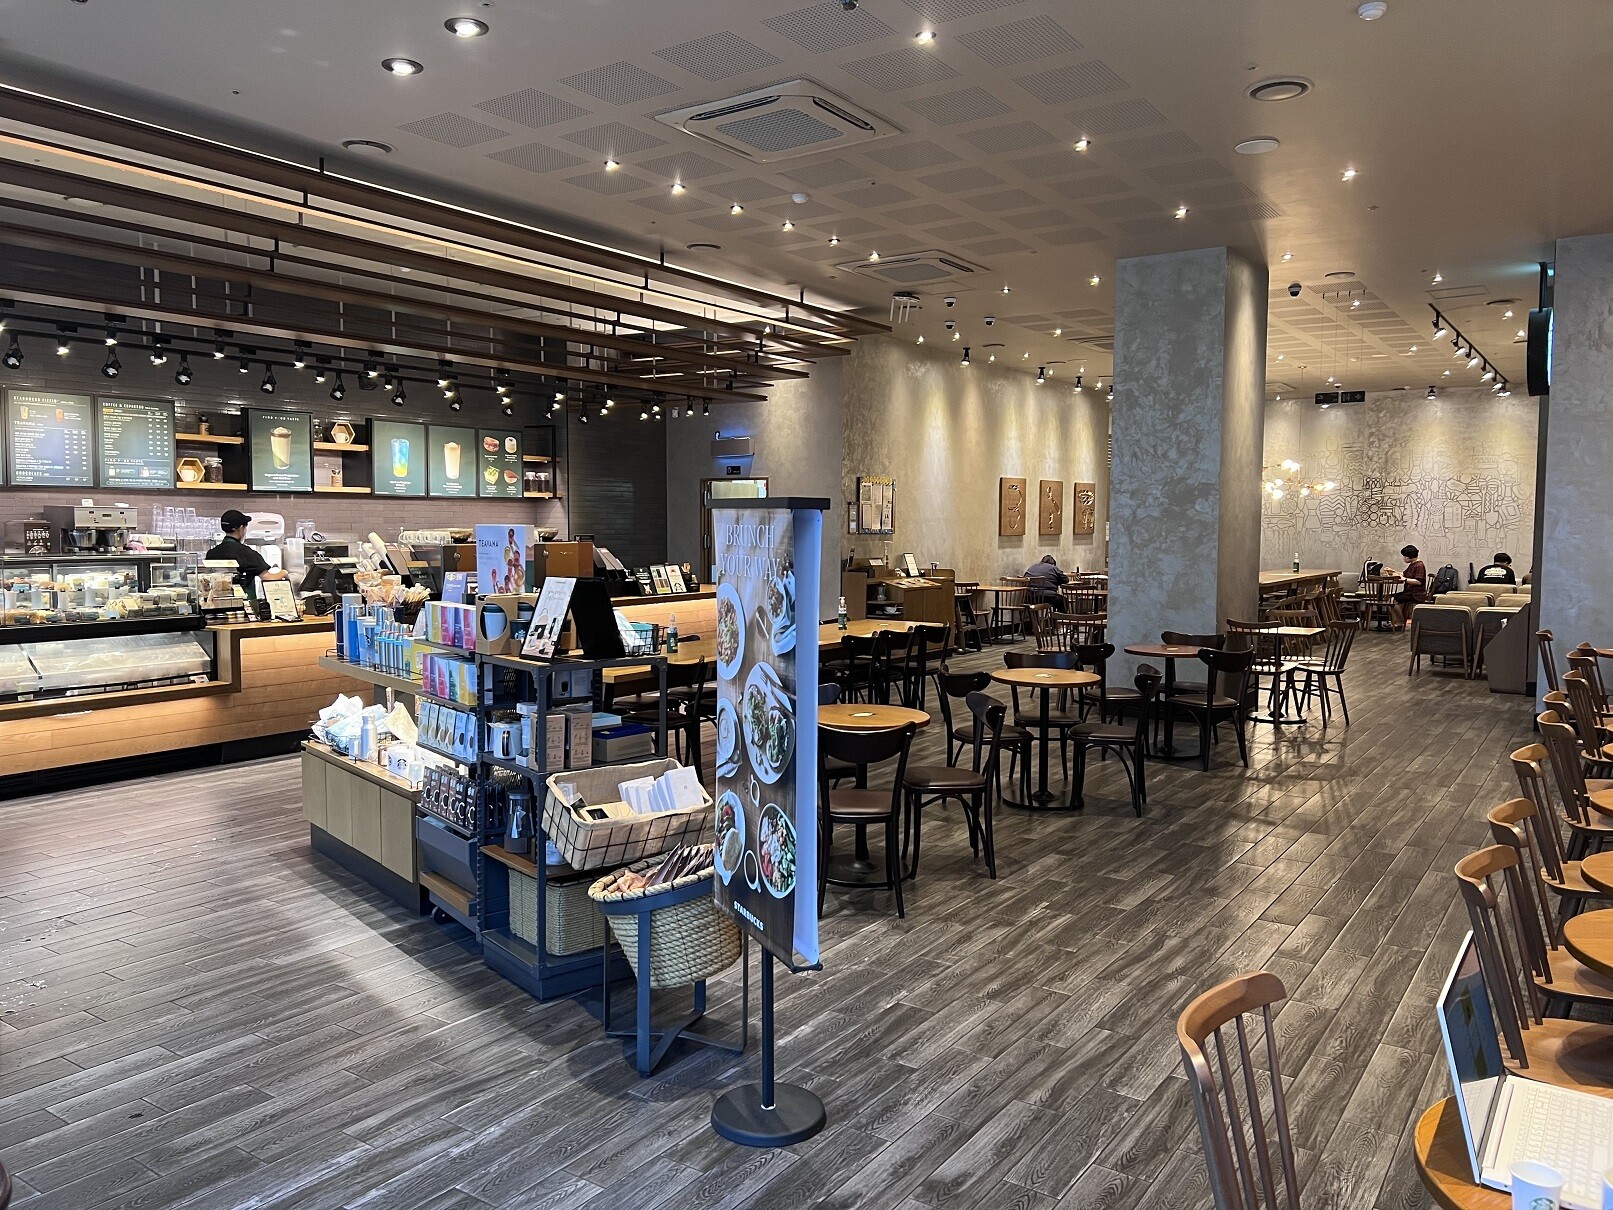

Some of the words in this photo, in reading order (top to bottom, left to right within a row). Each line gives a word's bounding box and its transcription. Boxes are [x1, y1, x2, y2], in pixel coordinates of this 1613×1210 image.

[478, 539, 500, 548] TEAVANA
[725, 524, 775, 548] BRUNCH
[719, 553, 751, 578] YOUR
[754, 556, 780, 581] WAY
[733, 900, 764, 931] STARBUCKS
